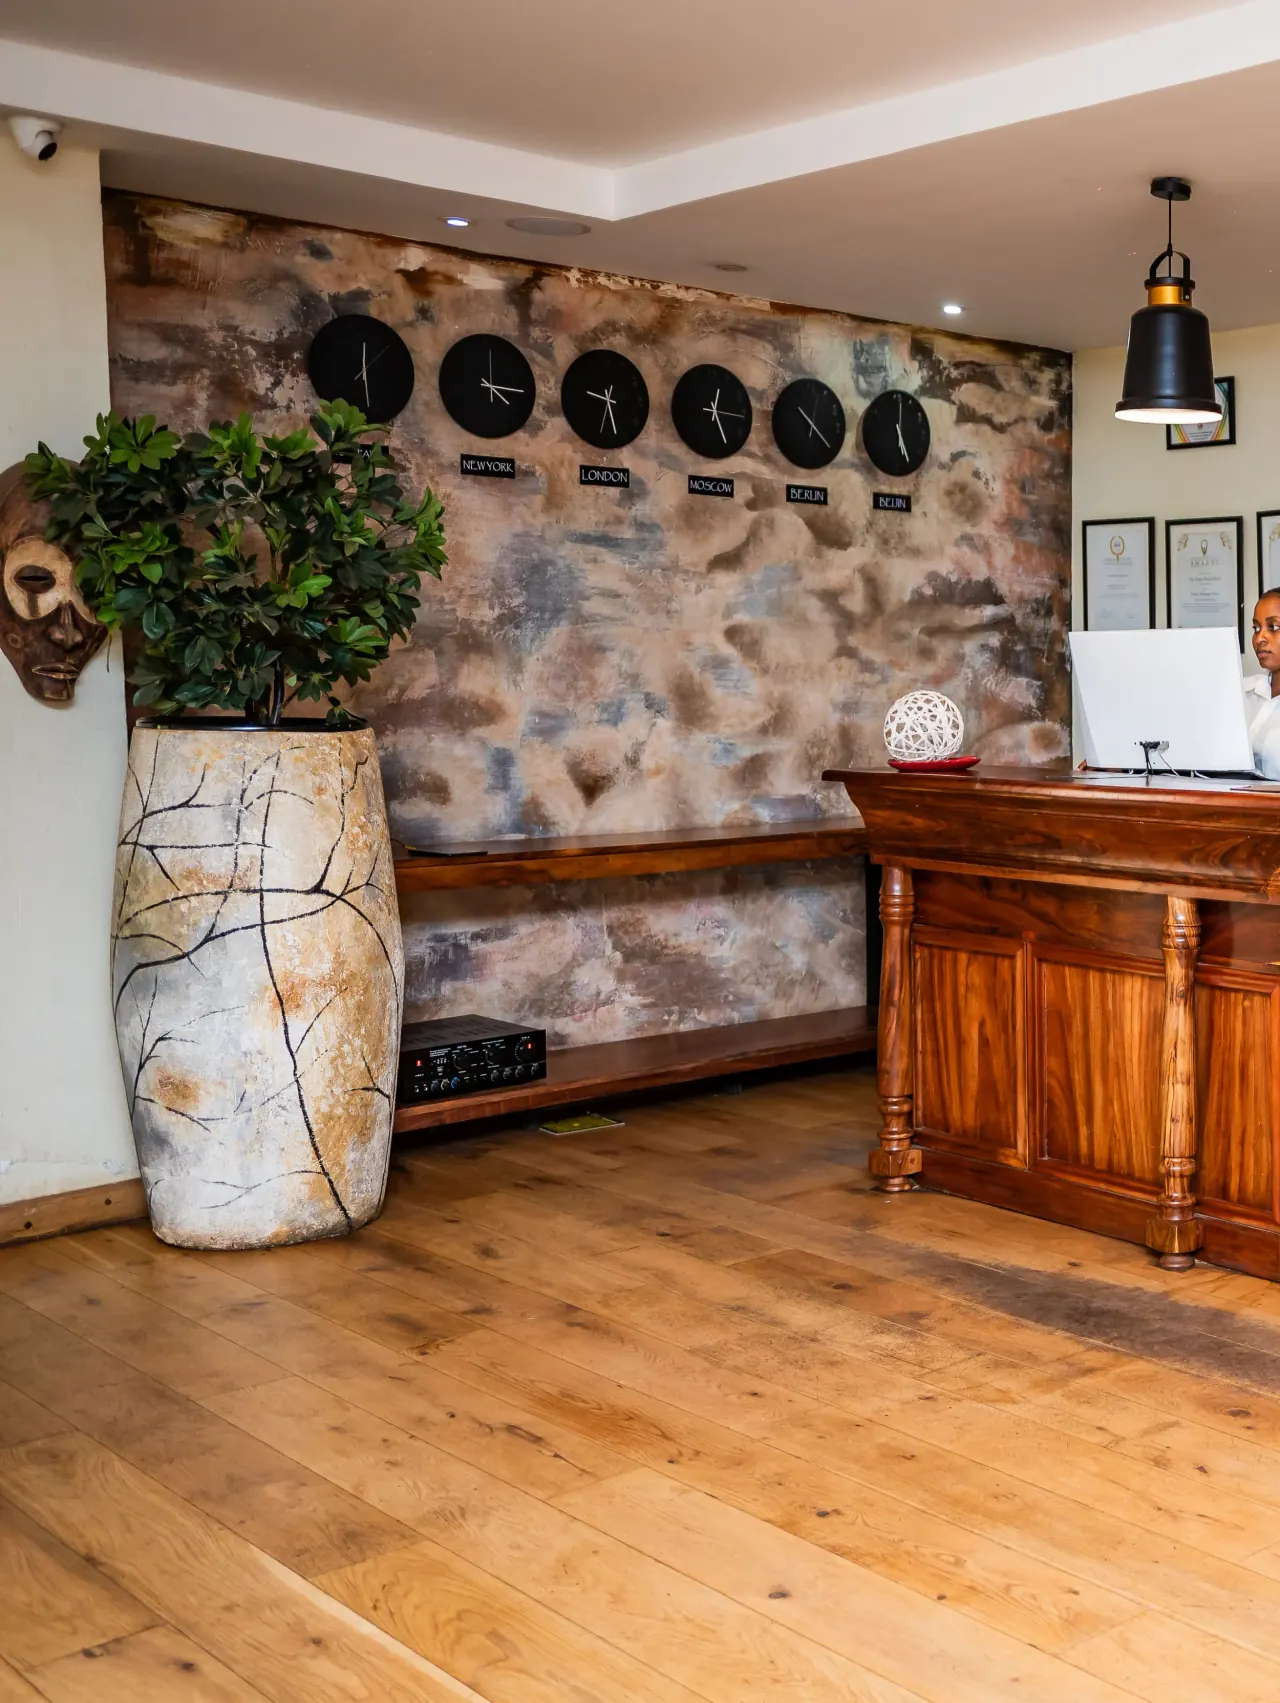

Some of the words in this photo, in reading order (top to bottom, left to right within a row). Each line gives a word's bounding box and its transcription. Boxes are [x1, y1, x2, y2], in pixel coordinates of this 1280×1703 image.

[487, 461, 514, 473] YORK
[581, 469, 628, 483] LONDON
[689, 479, 732, 493] MOSCOW
[790, 487, 824, 502] BERLIN
